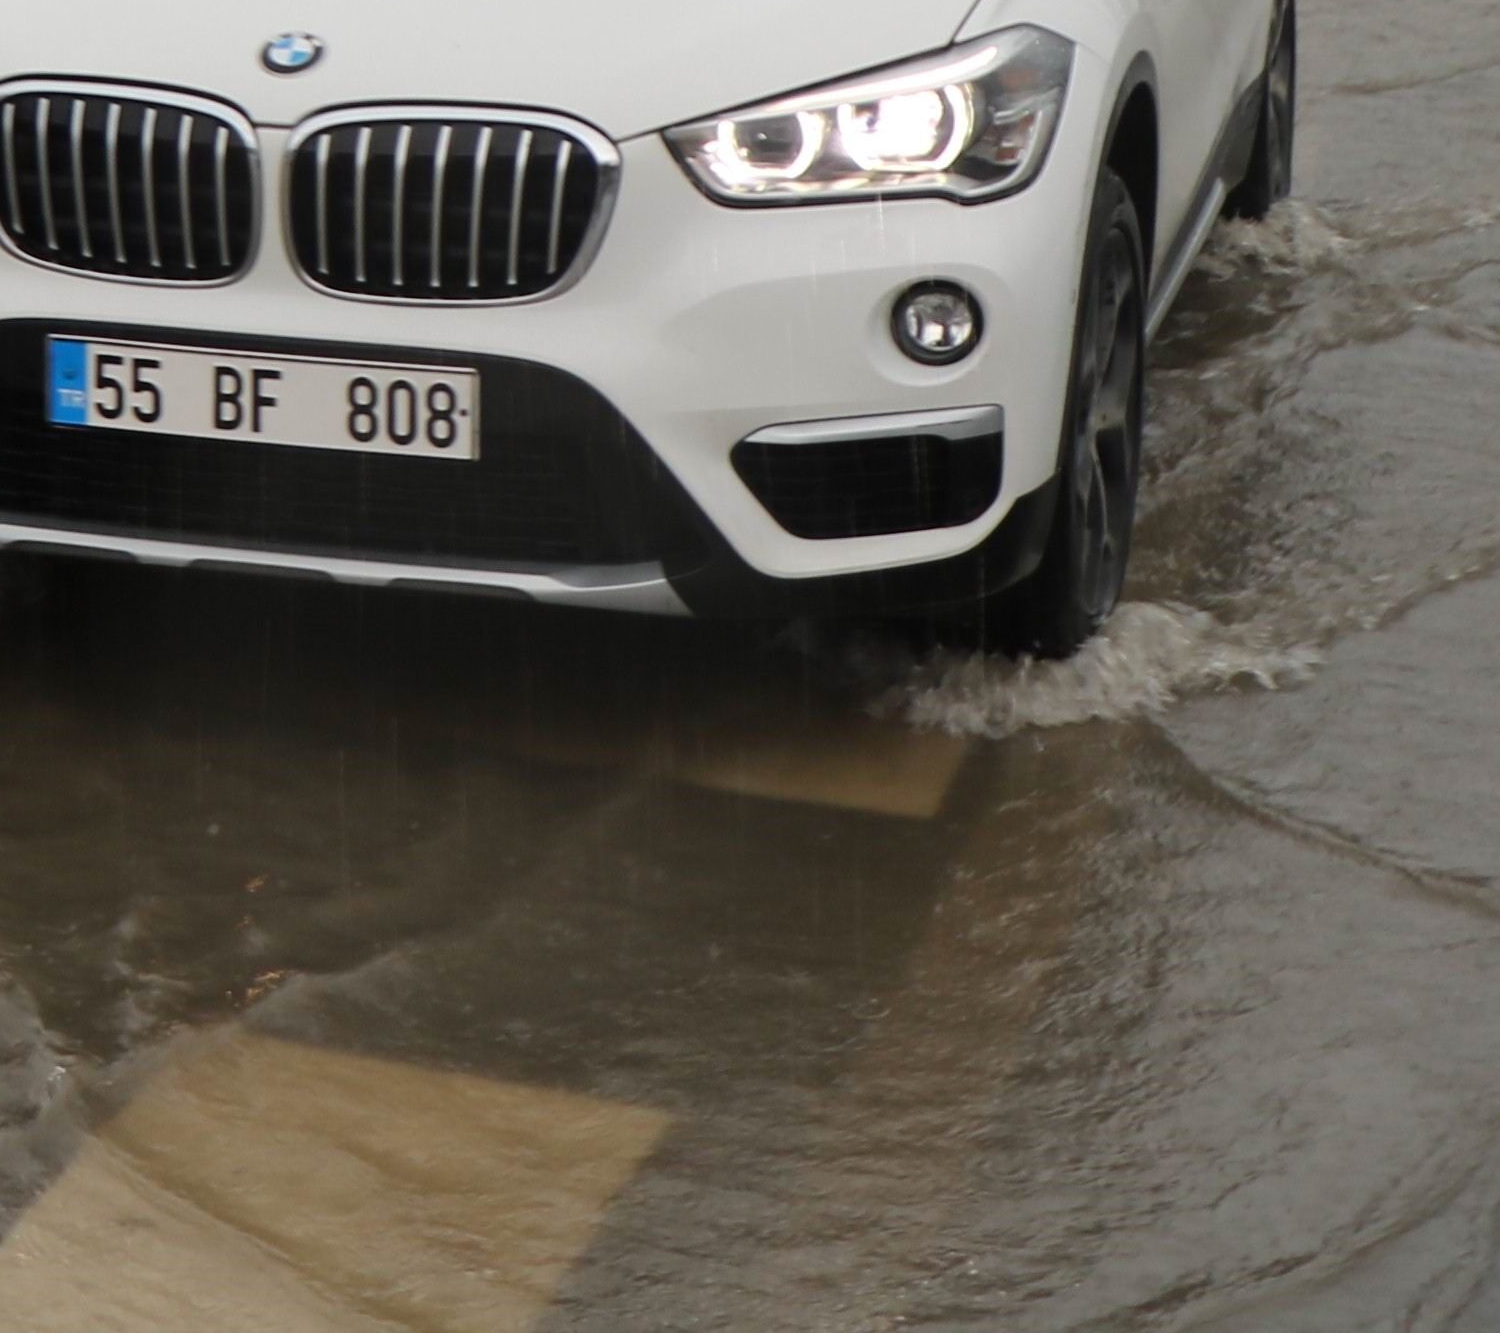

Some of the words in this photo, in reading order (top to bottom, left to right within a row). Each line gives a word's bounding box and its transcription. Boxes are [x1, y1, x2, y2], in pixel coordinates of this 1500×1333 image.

[93, 353, 162, 424] 55
[213, 365, 283, 433] BF
[346, 375, 458, 449] 808
